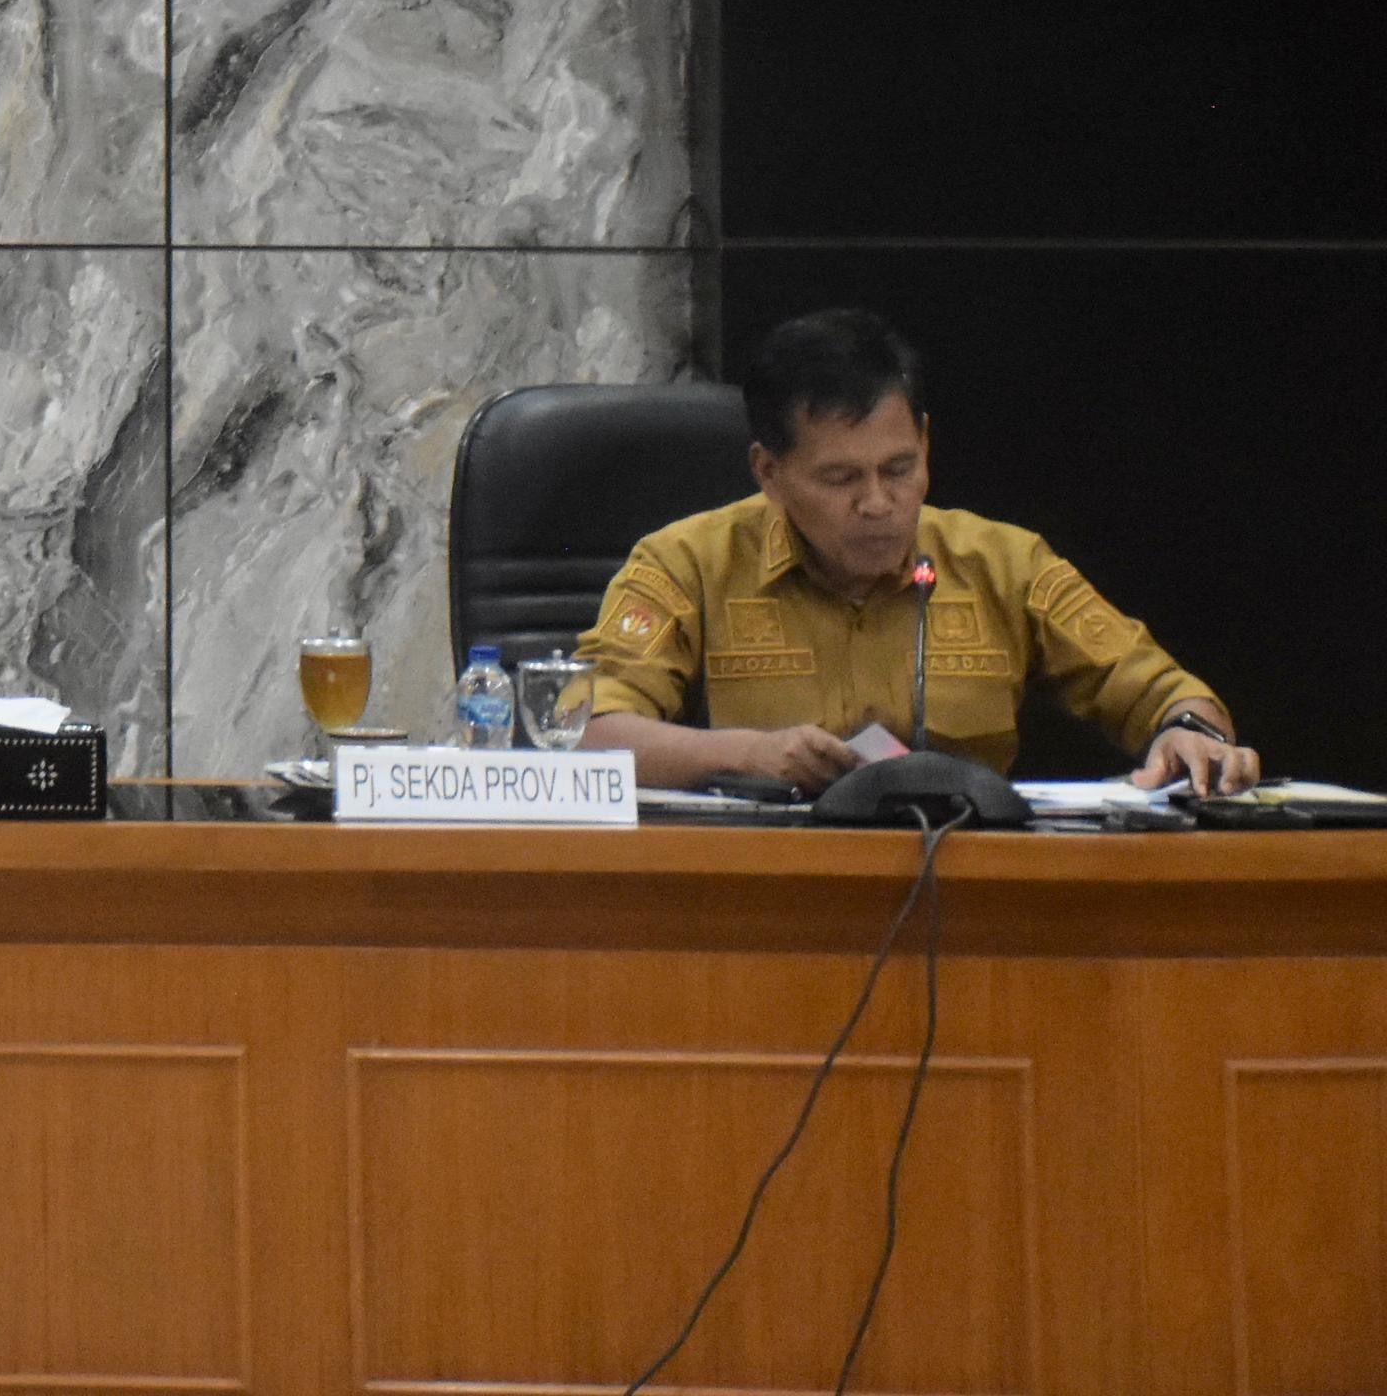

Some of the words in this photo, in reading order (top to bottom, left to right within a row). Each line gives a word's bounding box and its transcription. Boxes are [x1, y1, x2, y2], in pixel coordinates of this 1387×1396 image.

[352, 763, 381, 807] Pj.
[389, 764, 477, 801] SEKDA
[485, 766, 564, 802] PROV.
[572, 768, 624, 803] NTB
